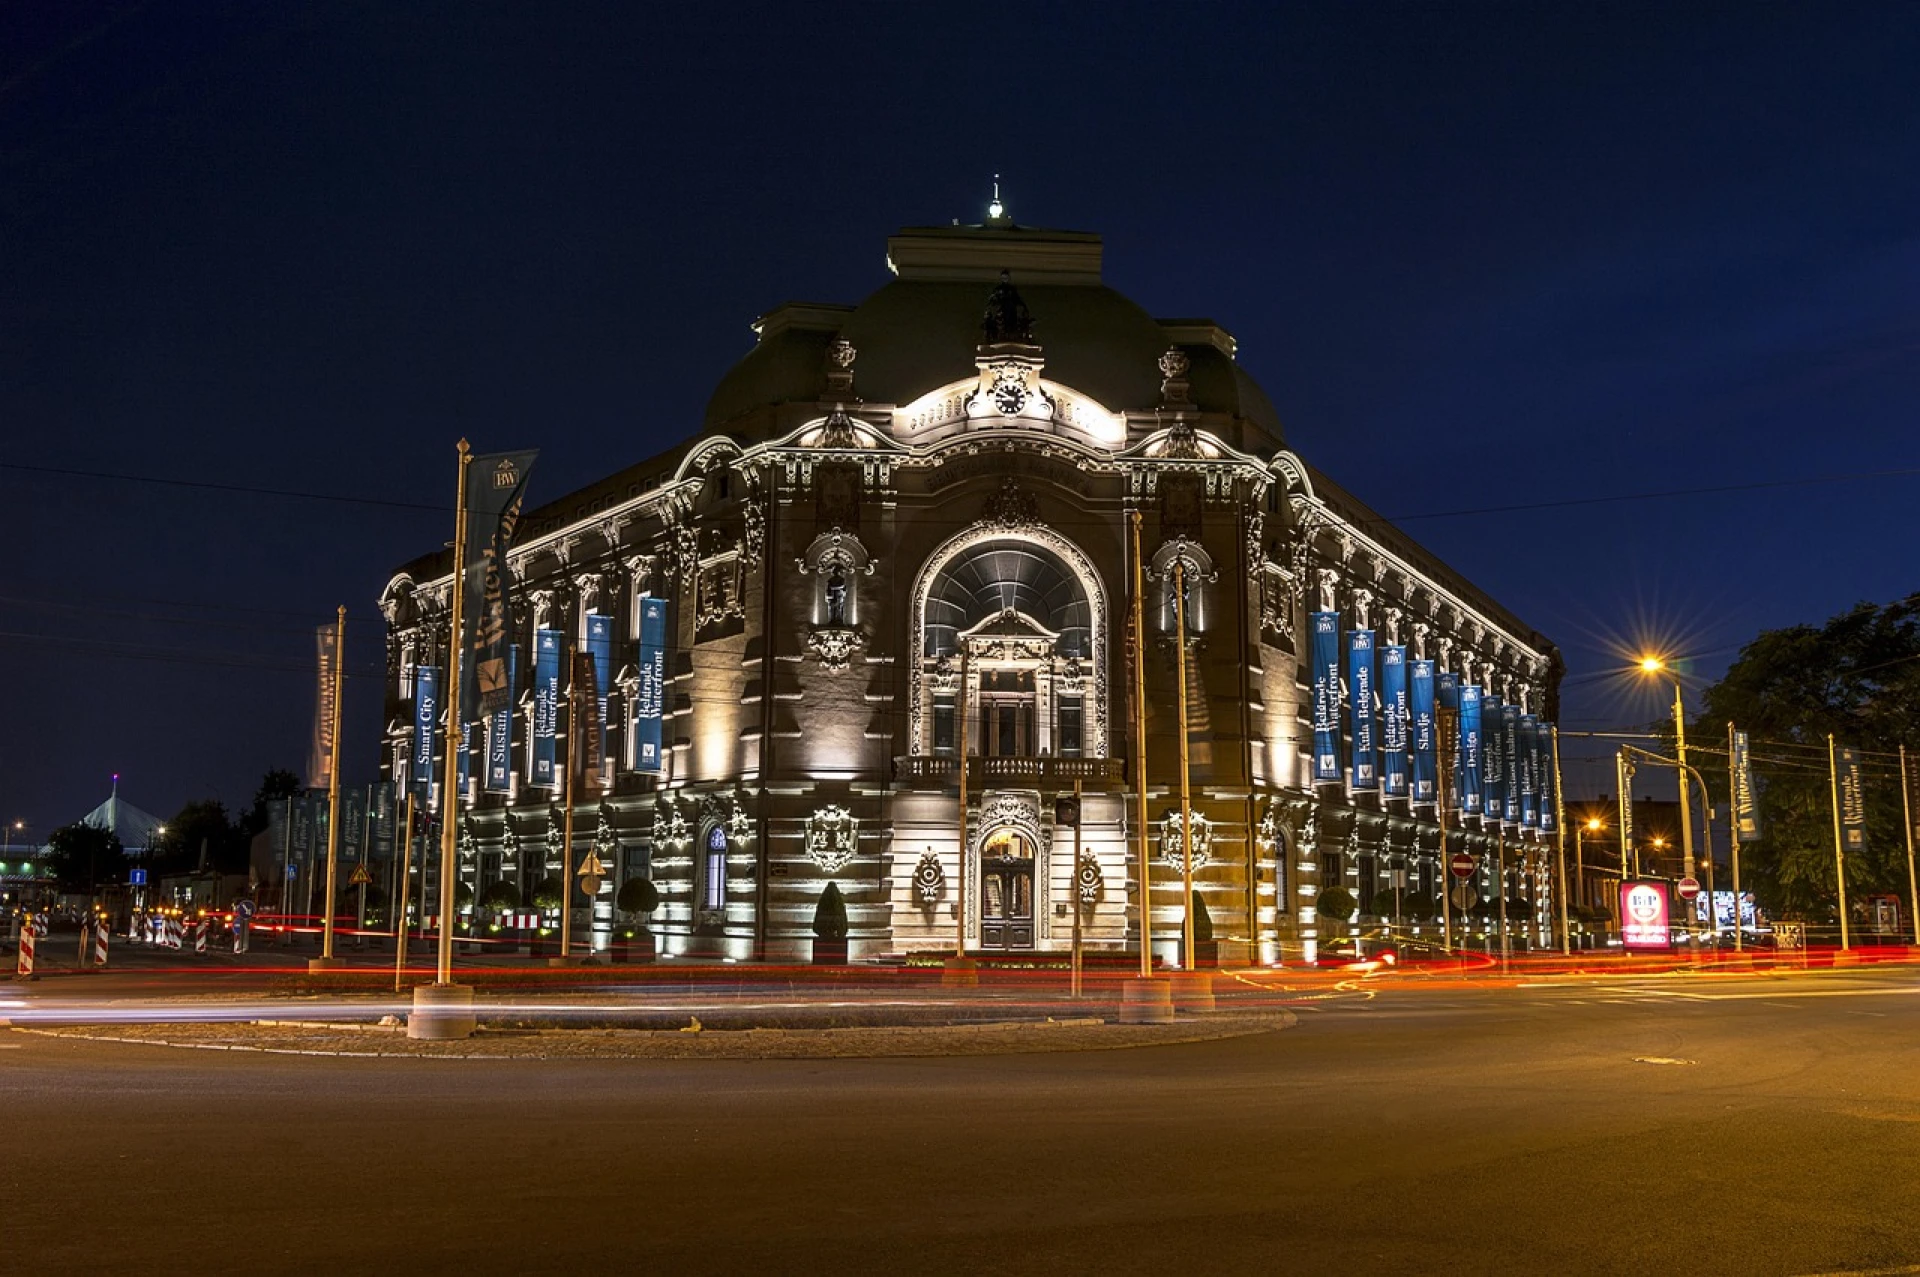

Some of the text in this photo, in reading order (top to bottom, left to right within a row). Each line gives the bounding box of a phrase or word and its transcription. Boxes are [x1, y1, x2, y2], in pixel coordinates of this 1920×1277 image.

[535, 689, 547, 739] Belgrade
[546, 676, 558, 738] Waterfront
[638, 663, 652, 719] Belgrade
[650, 650, 664, 718] Waterfront
[1314, 676, 1330, 732] Belgrade
[1326, 662, 1340, 731] Waterfront
[1357, 666, 1371, 753] Kula Belgrade
[418, 695, 435, 765] Smart City
[1384, 704, 1397, 753] Belgrade
[1394, 690, 1407, 752] Waterfront
[1466, 731, 1478, 768] Design
